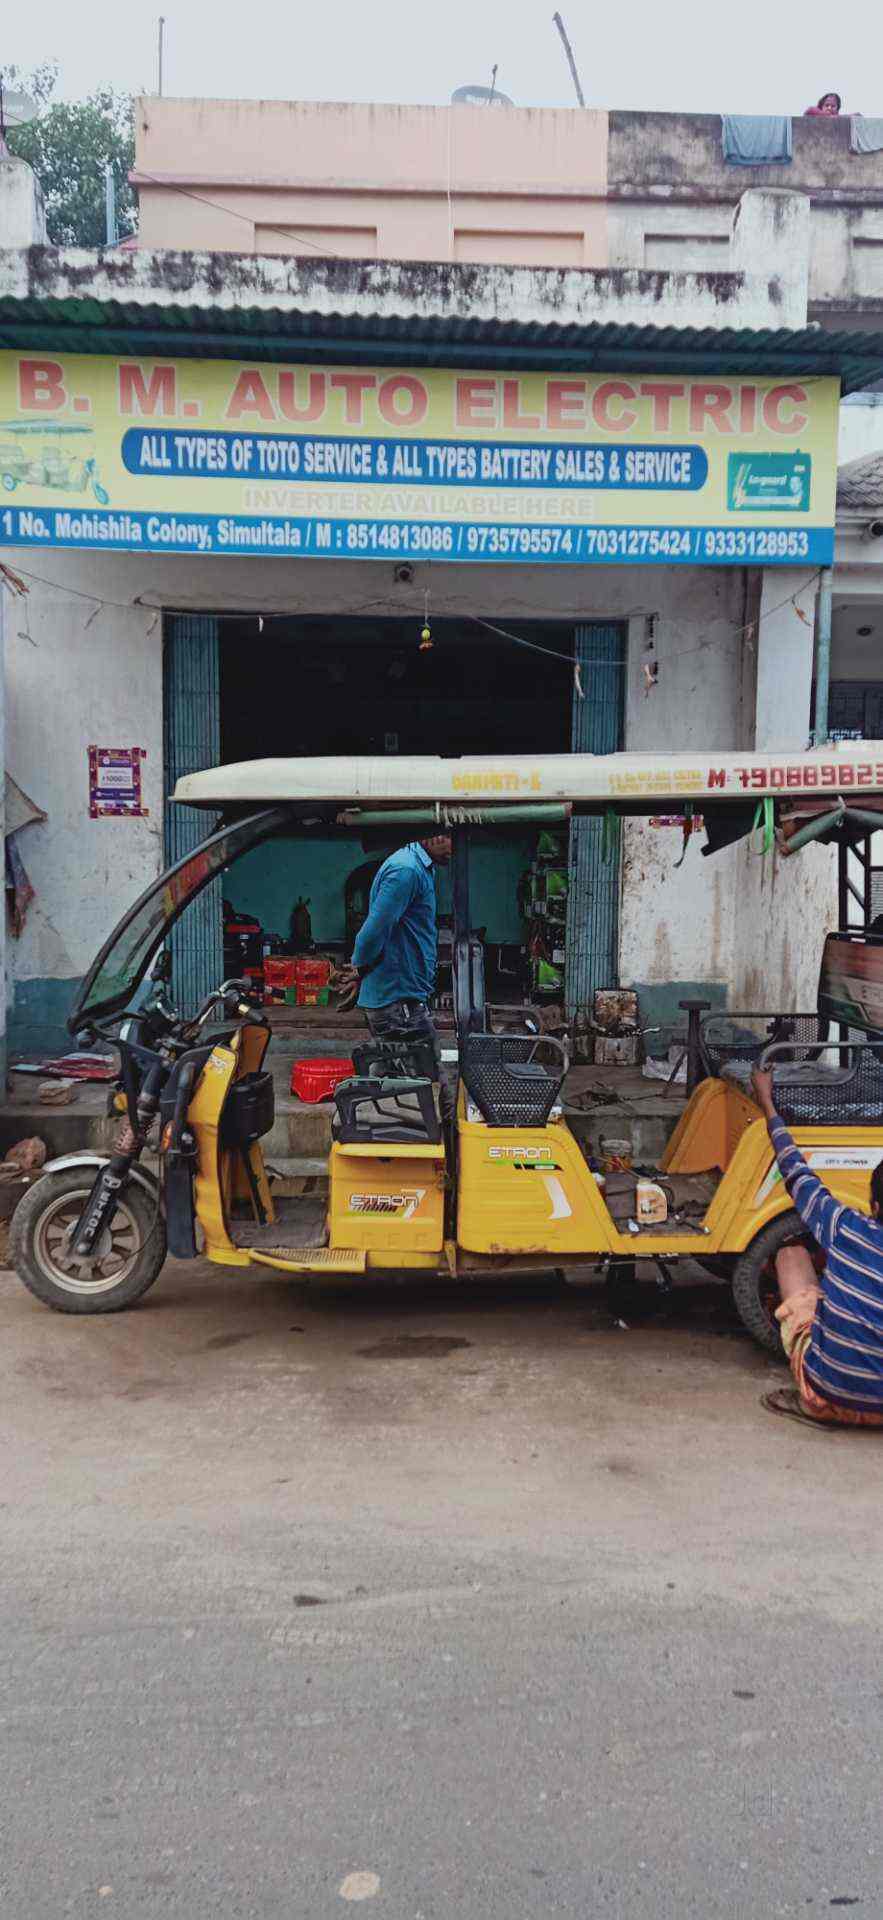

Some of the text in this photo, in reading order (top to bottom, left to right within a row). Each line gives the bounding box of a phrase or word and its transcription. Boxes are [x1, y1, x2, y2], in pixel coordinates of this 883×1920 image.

[18, 359, 808, 435] B. M. AUTO ELECTRIC
[139, 435, 692, 484] ALL TYPES OF TOTO SERVICE & ALL TYPES BATTERY SALES & SERVICE
[243, 487, 595, 518] INVERTER AVAILABLE HERE
[2, 511, 13, 536] 1
[18, 511, 50, 537] No.
[55, 512, 143, 542] Mohishila
[147, 516, 213, 549] Colony,
[217, 518, 301, 546] Simultala
[346, 523, 453, 551] 8514813086
[467, 526, 572, 554] 9735795574
[587, 529, 692, 556] 7031275424
[704, 530, 809, 557] 9333128953
